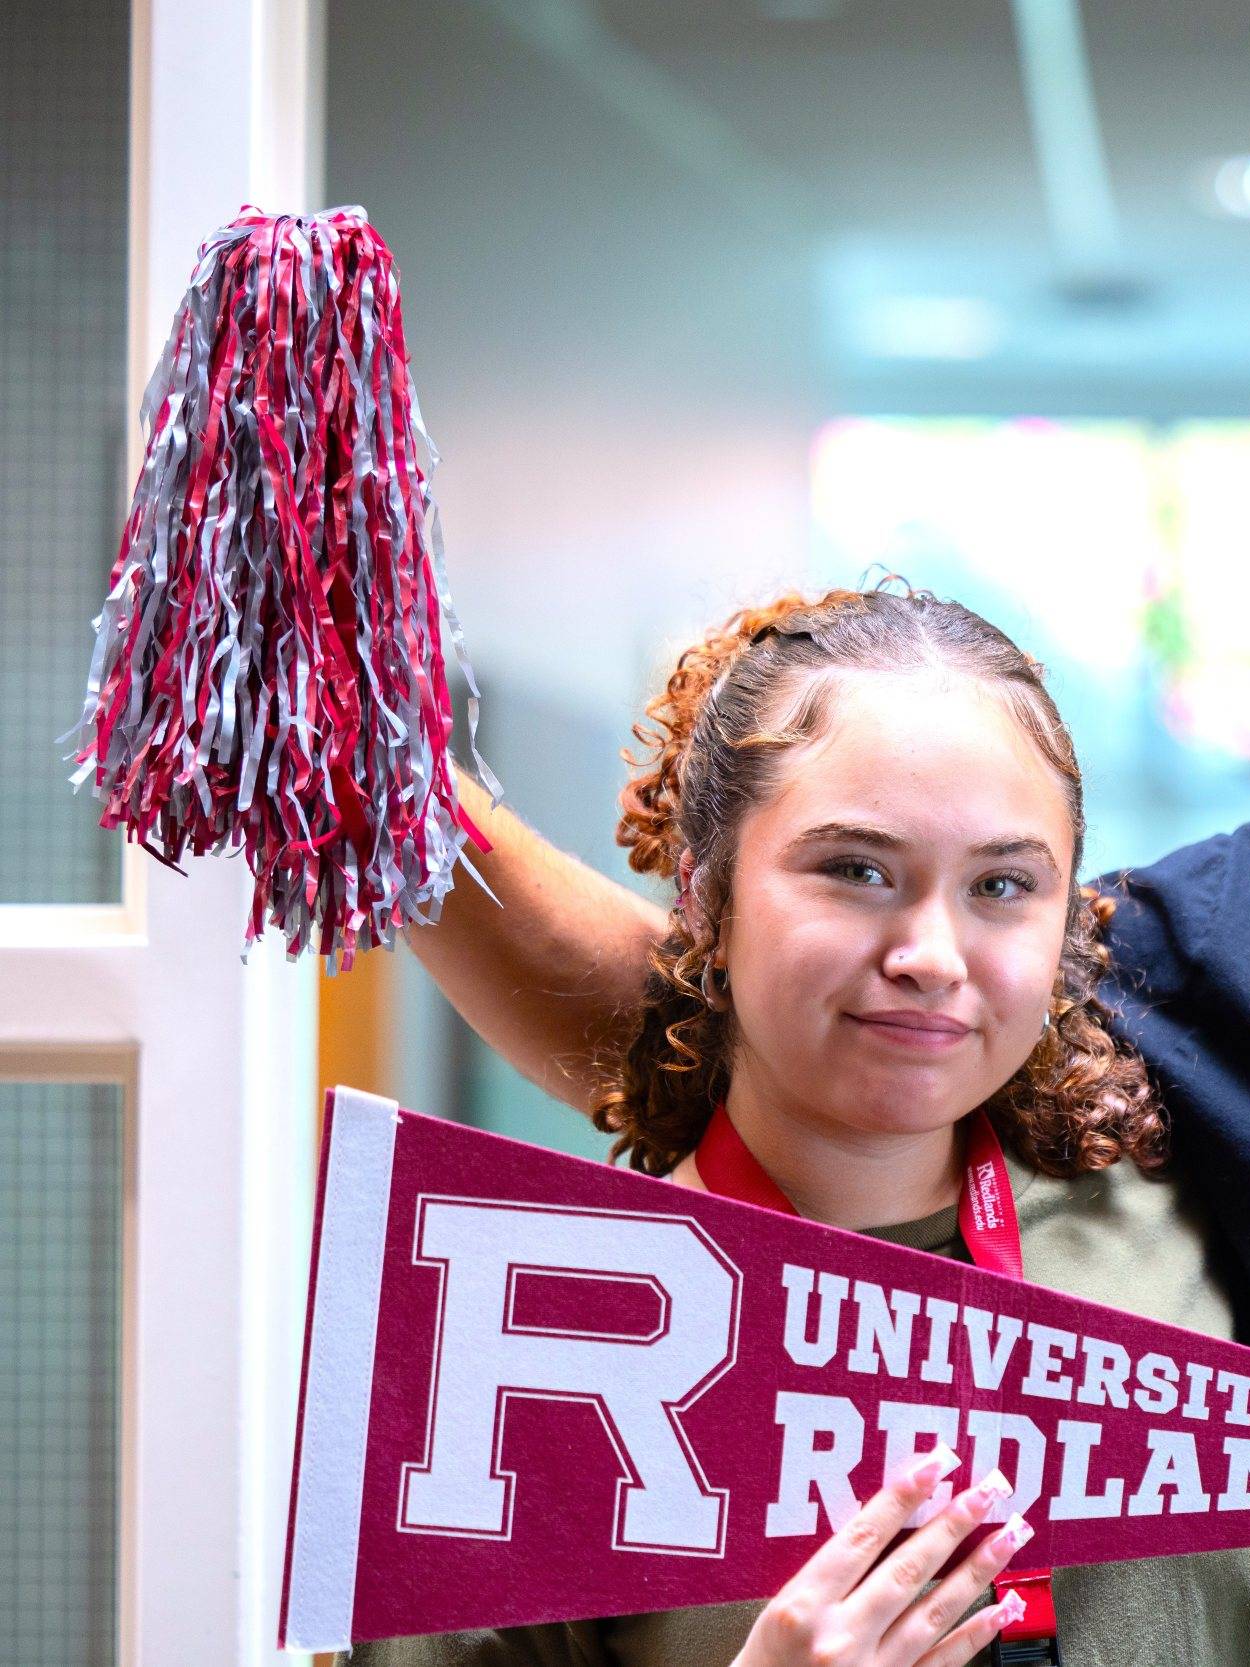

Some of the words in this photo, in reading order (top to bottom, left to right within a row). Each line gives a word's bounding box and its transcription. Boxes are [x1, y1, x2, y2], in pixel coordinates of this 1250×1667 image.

[967, 1166, 985, 1230] www.redlands.edu
[979, 1180, 999, 1228] Redlands
[396, 1192, 744, 1560] R
